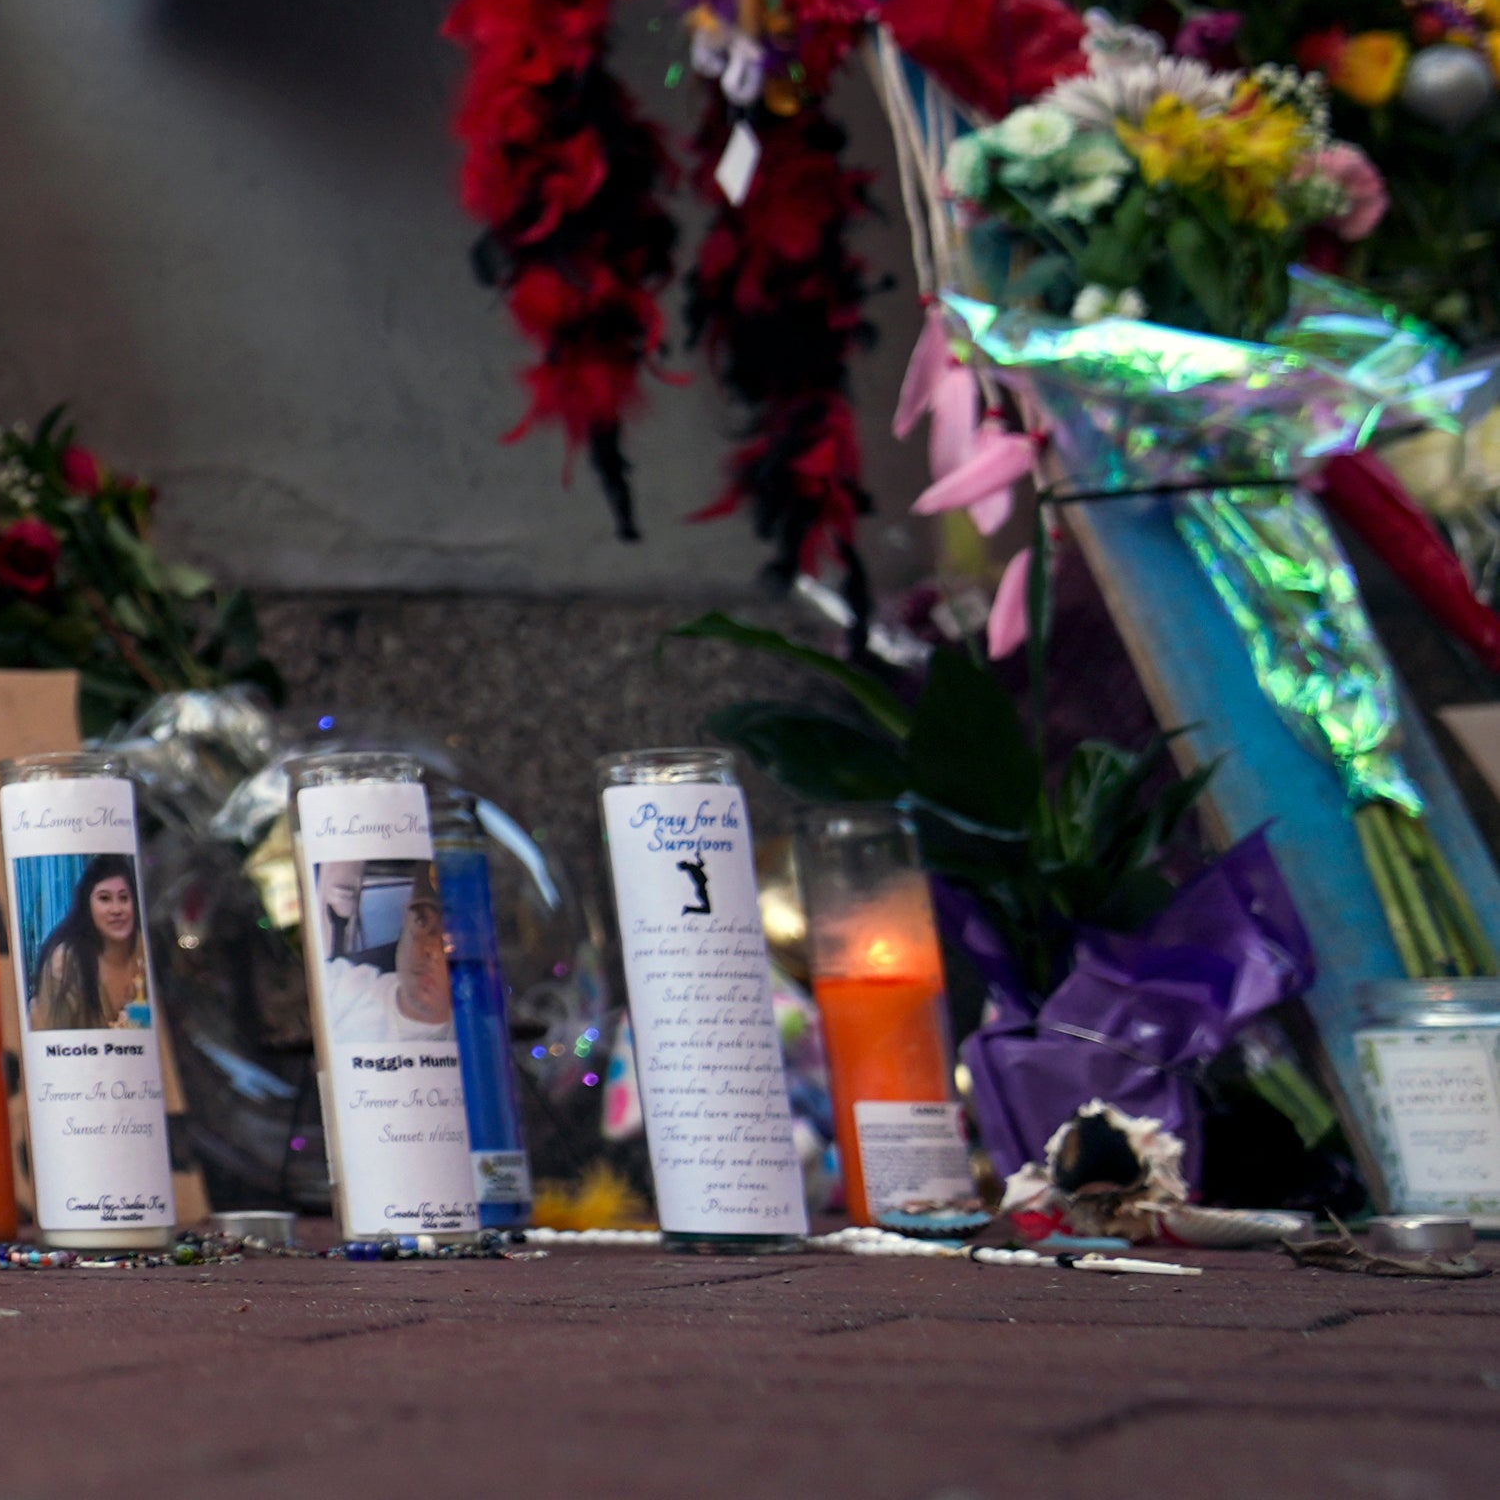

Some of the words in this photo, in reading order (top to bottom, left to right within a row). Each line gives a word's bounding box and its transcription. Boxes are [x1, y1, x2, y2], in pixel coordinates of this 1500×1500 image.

[12, 809, 30, 832] In
[34, 808, 82, 834] Loving
[315, 816, 337, 838] In
[341, 814, 391, 839] Loving
[630, 803, 687, 835] Pray
[686, 800, 716, 836] for
[648, 829, 734, 852] Survivors
[46, 1044, 99, 1057] Nicole
[104, 1043, 145, 1056] Perez
[352, 1056, 415, 1072] Reggie
[38, 1082, 81, 1102] Forever
[85, 1081, 106, 1100] In
[110, 1081, 136, 1100] Our
[349, 1089, 398, 1110] Forever
[402, 1088, 423, 1108] In
[426, 1087, 450, 1108] Our
[62, 1116, 106, 1136] Sunset:
[111, 1114, 153, 1138] 1/1/2025
[378, 1123, 423, 1143] Sunset:
[66, 1196, 100, 1212] Created
[384, 1203, 420, 1220] Created
